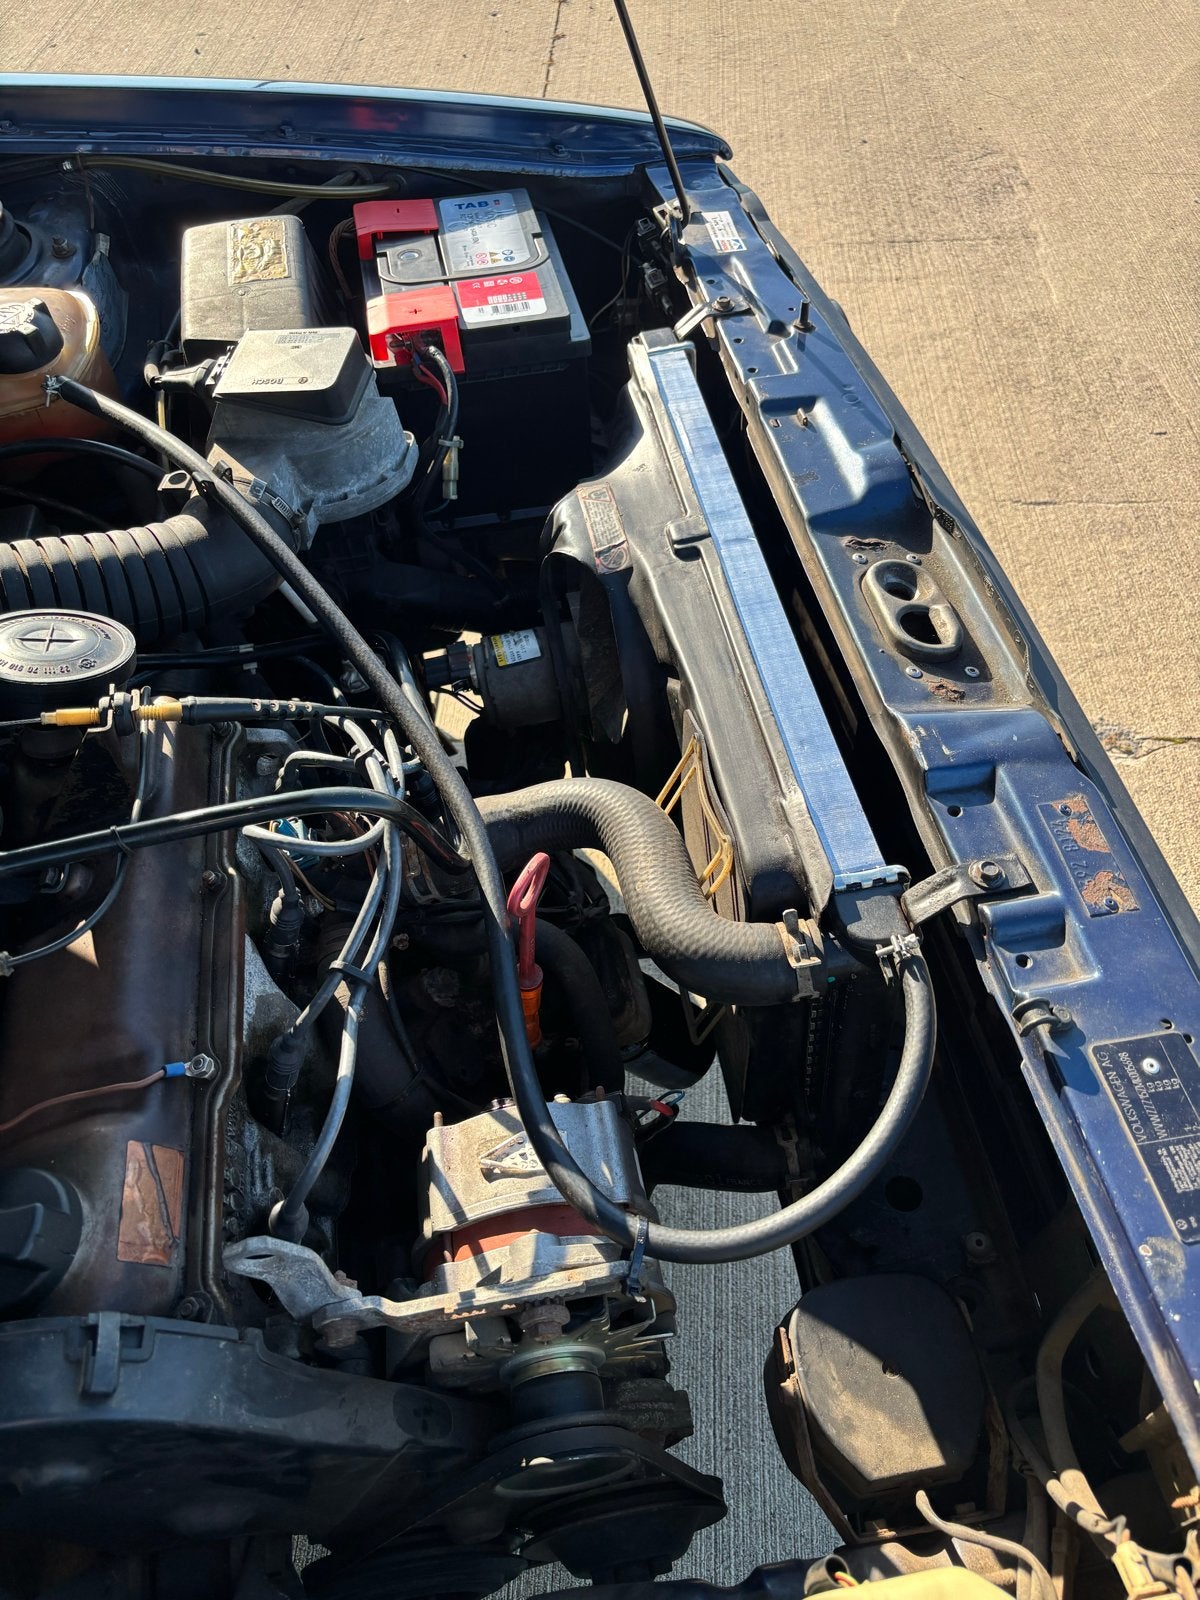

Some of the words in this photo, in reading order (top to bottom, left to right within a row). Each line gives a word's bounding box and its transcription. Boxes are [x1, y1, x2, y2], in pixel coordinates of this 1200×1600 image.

[454, 201, 489, 210] TAB
[252, 378, 284, 386] BOSCH
[1097, 1051, 1113, 1068] AG
[1146, 1082, 1156, 1093] kg
[1155, 1081, 1163, 1092] kg
[1162, 1079, 1172, 1090] kg
[1171, 1078, 1180, 1089] kg
[1106, 1071, 1147, 1143] VOLKSWAGEN
